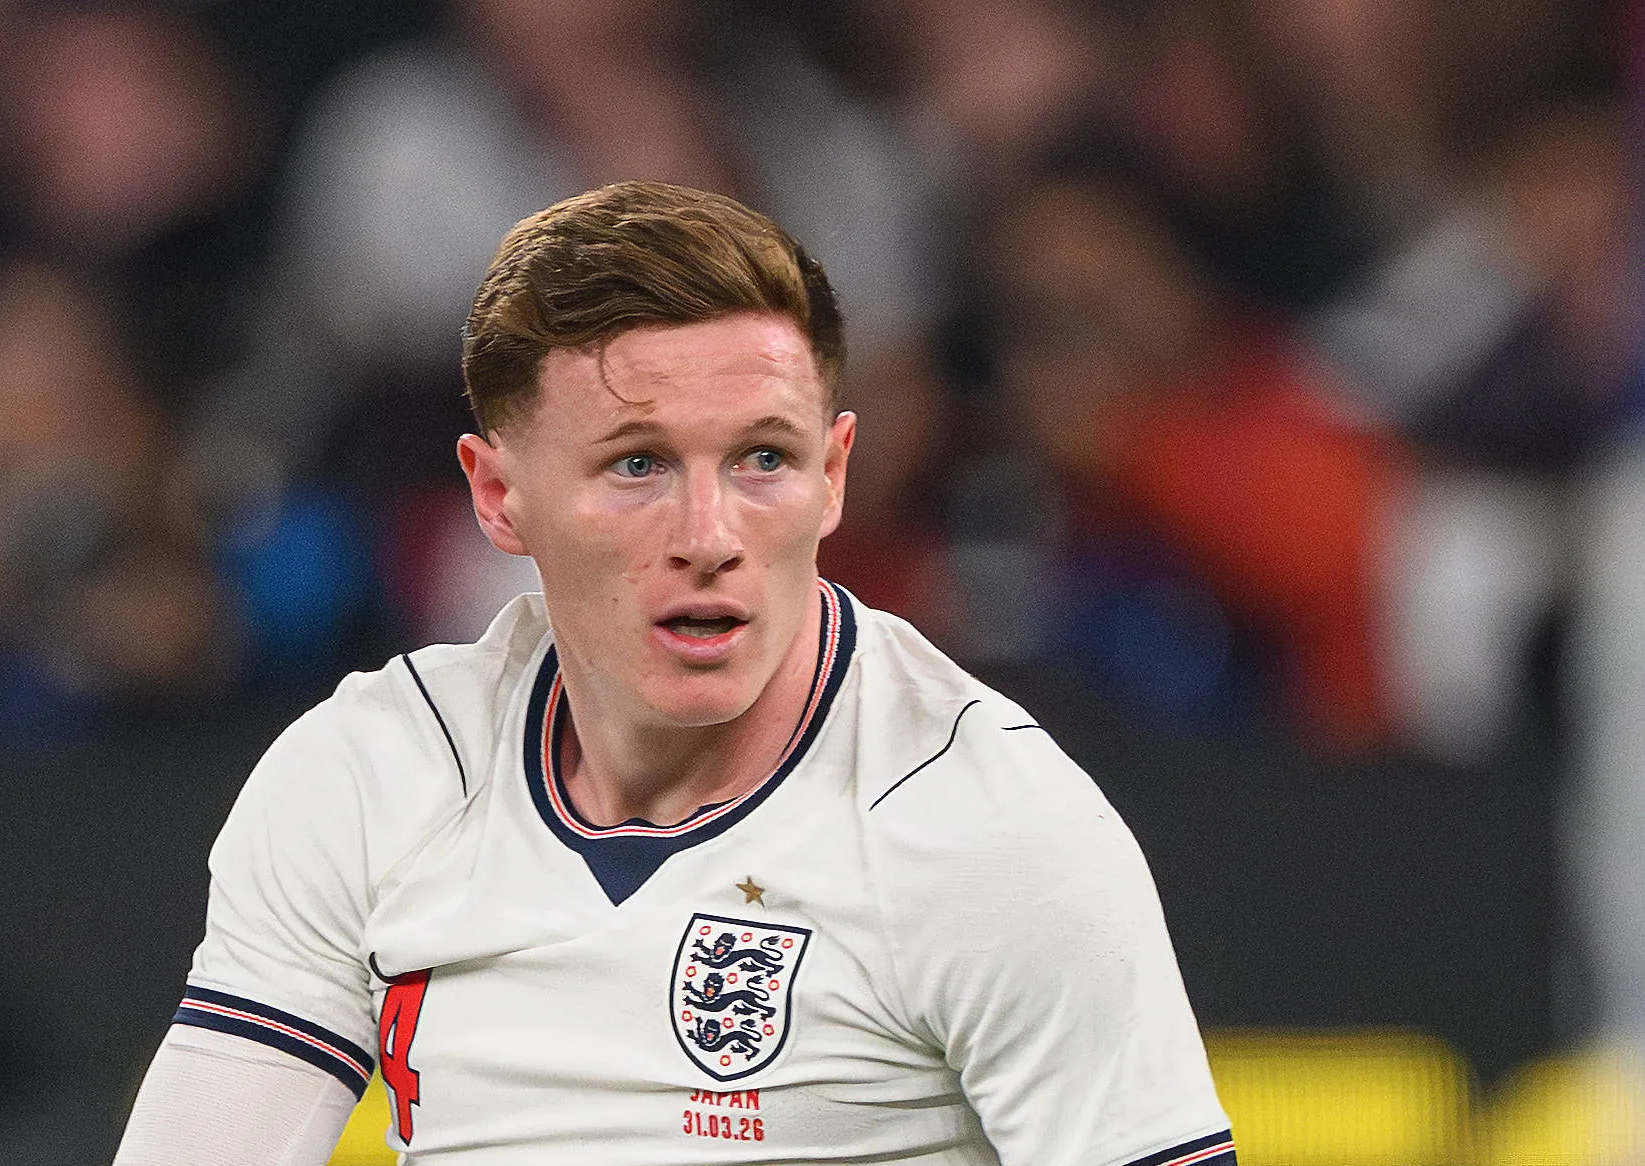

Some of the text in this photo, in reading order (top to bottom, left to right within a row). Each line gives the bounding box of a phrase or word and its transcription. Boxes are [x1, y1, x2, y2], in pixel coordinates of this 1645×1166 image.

[378, 966, 433, 1147] 4
[690, 1088, 760, 1110] JAPAN
[683, 1110, 764, 1141] 31.03.26
